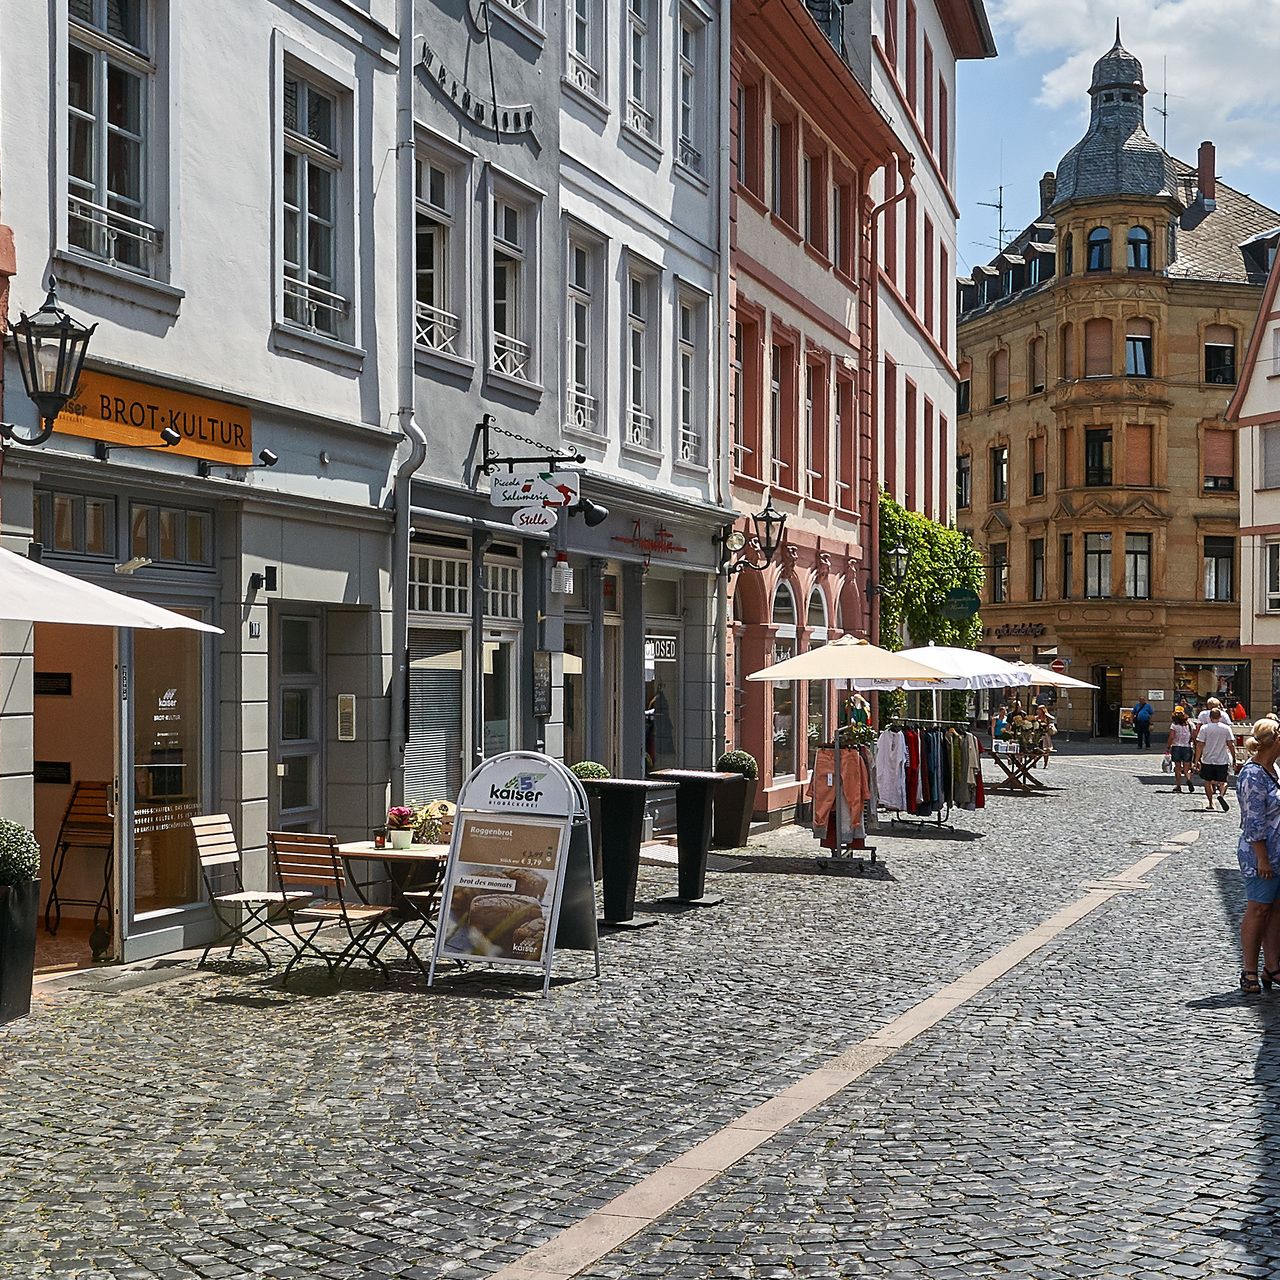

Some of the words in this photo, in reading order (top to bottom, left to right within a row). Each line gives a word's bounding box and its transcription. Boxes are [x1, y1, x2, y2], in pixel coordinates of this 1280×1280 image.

[494, 477, 521, 488] Piccola
[502, 489, 549, 502] Salumeria
[519, 512, 549, 526] Stella
[489, 783, 544, 803] kaiser
[470, 826, 513, 837] Roggenbrot
[527, 858, 543, 867] 3,79
[487, 879, 513, 889] monats
[512, 942, 538, 954] kaiser
